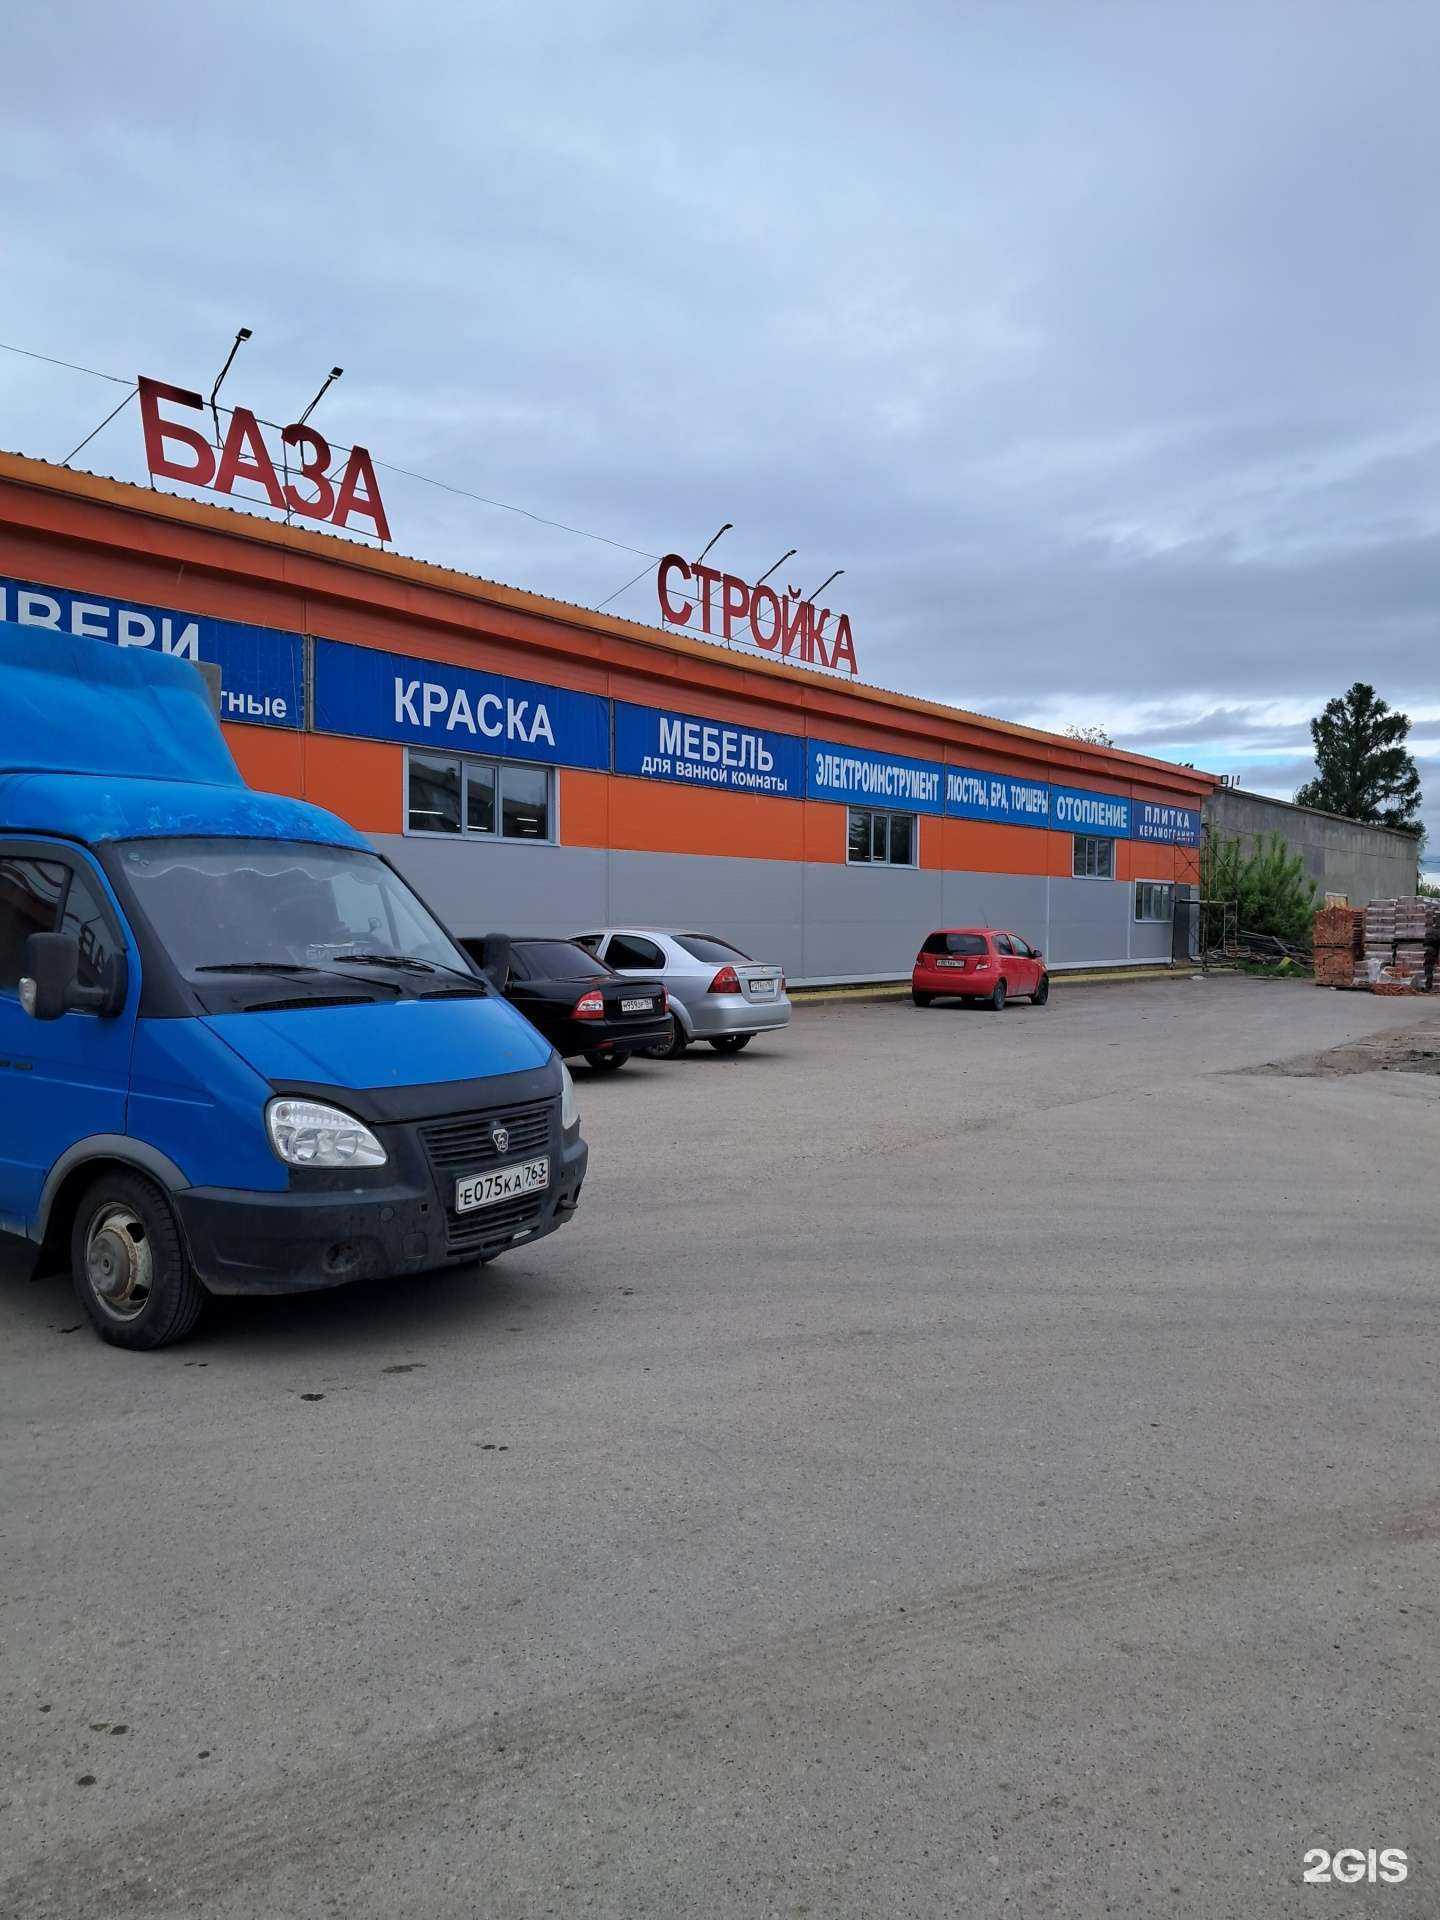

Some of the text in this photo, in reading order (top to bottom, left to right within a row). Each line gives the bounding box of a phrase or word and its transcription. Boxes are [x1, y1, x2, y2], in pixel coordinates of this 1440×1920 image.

[138, 375, 392, 542] БАЗА
[658, 554, 858, 674] СТРОЙКА
[395, 677, 556, 746] КРАСКА
[659, 717, 774, 772] МЕБЕЛЬ
[641, 756, 788, 791] для ванной комнаты
[815, 753, 939, 801] ЭЛЕКТРОИНСТРУМЕНТ
[947, 774, 1048, 814] ЛЮСТРЫ, БРА, ТОРШЕРЫ
[1056, 796, 1127, 828] ОТОПЛЕНИЕ
[1144, 806, 1190, 829] ПЛИТКА
